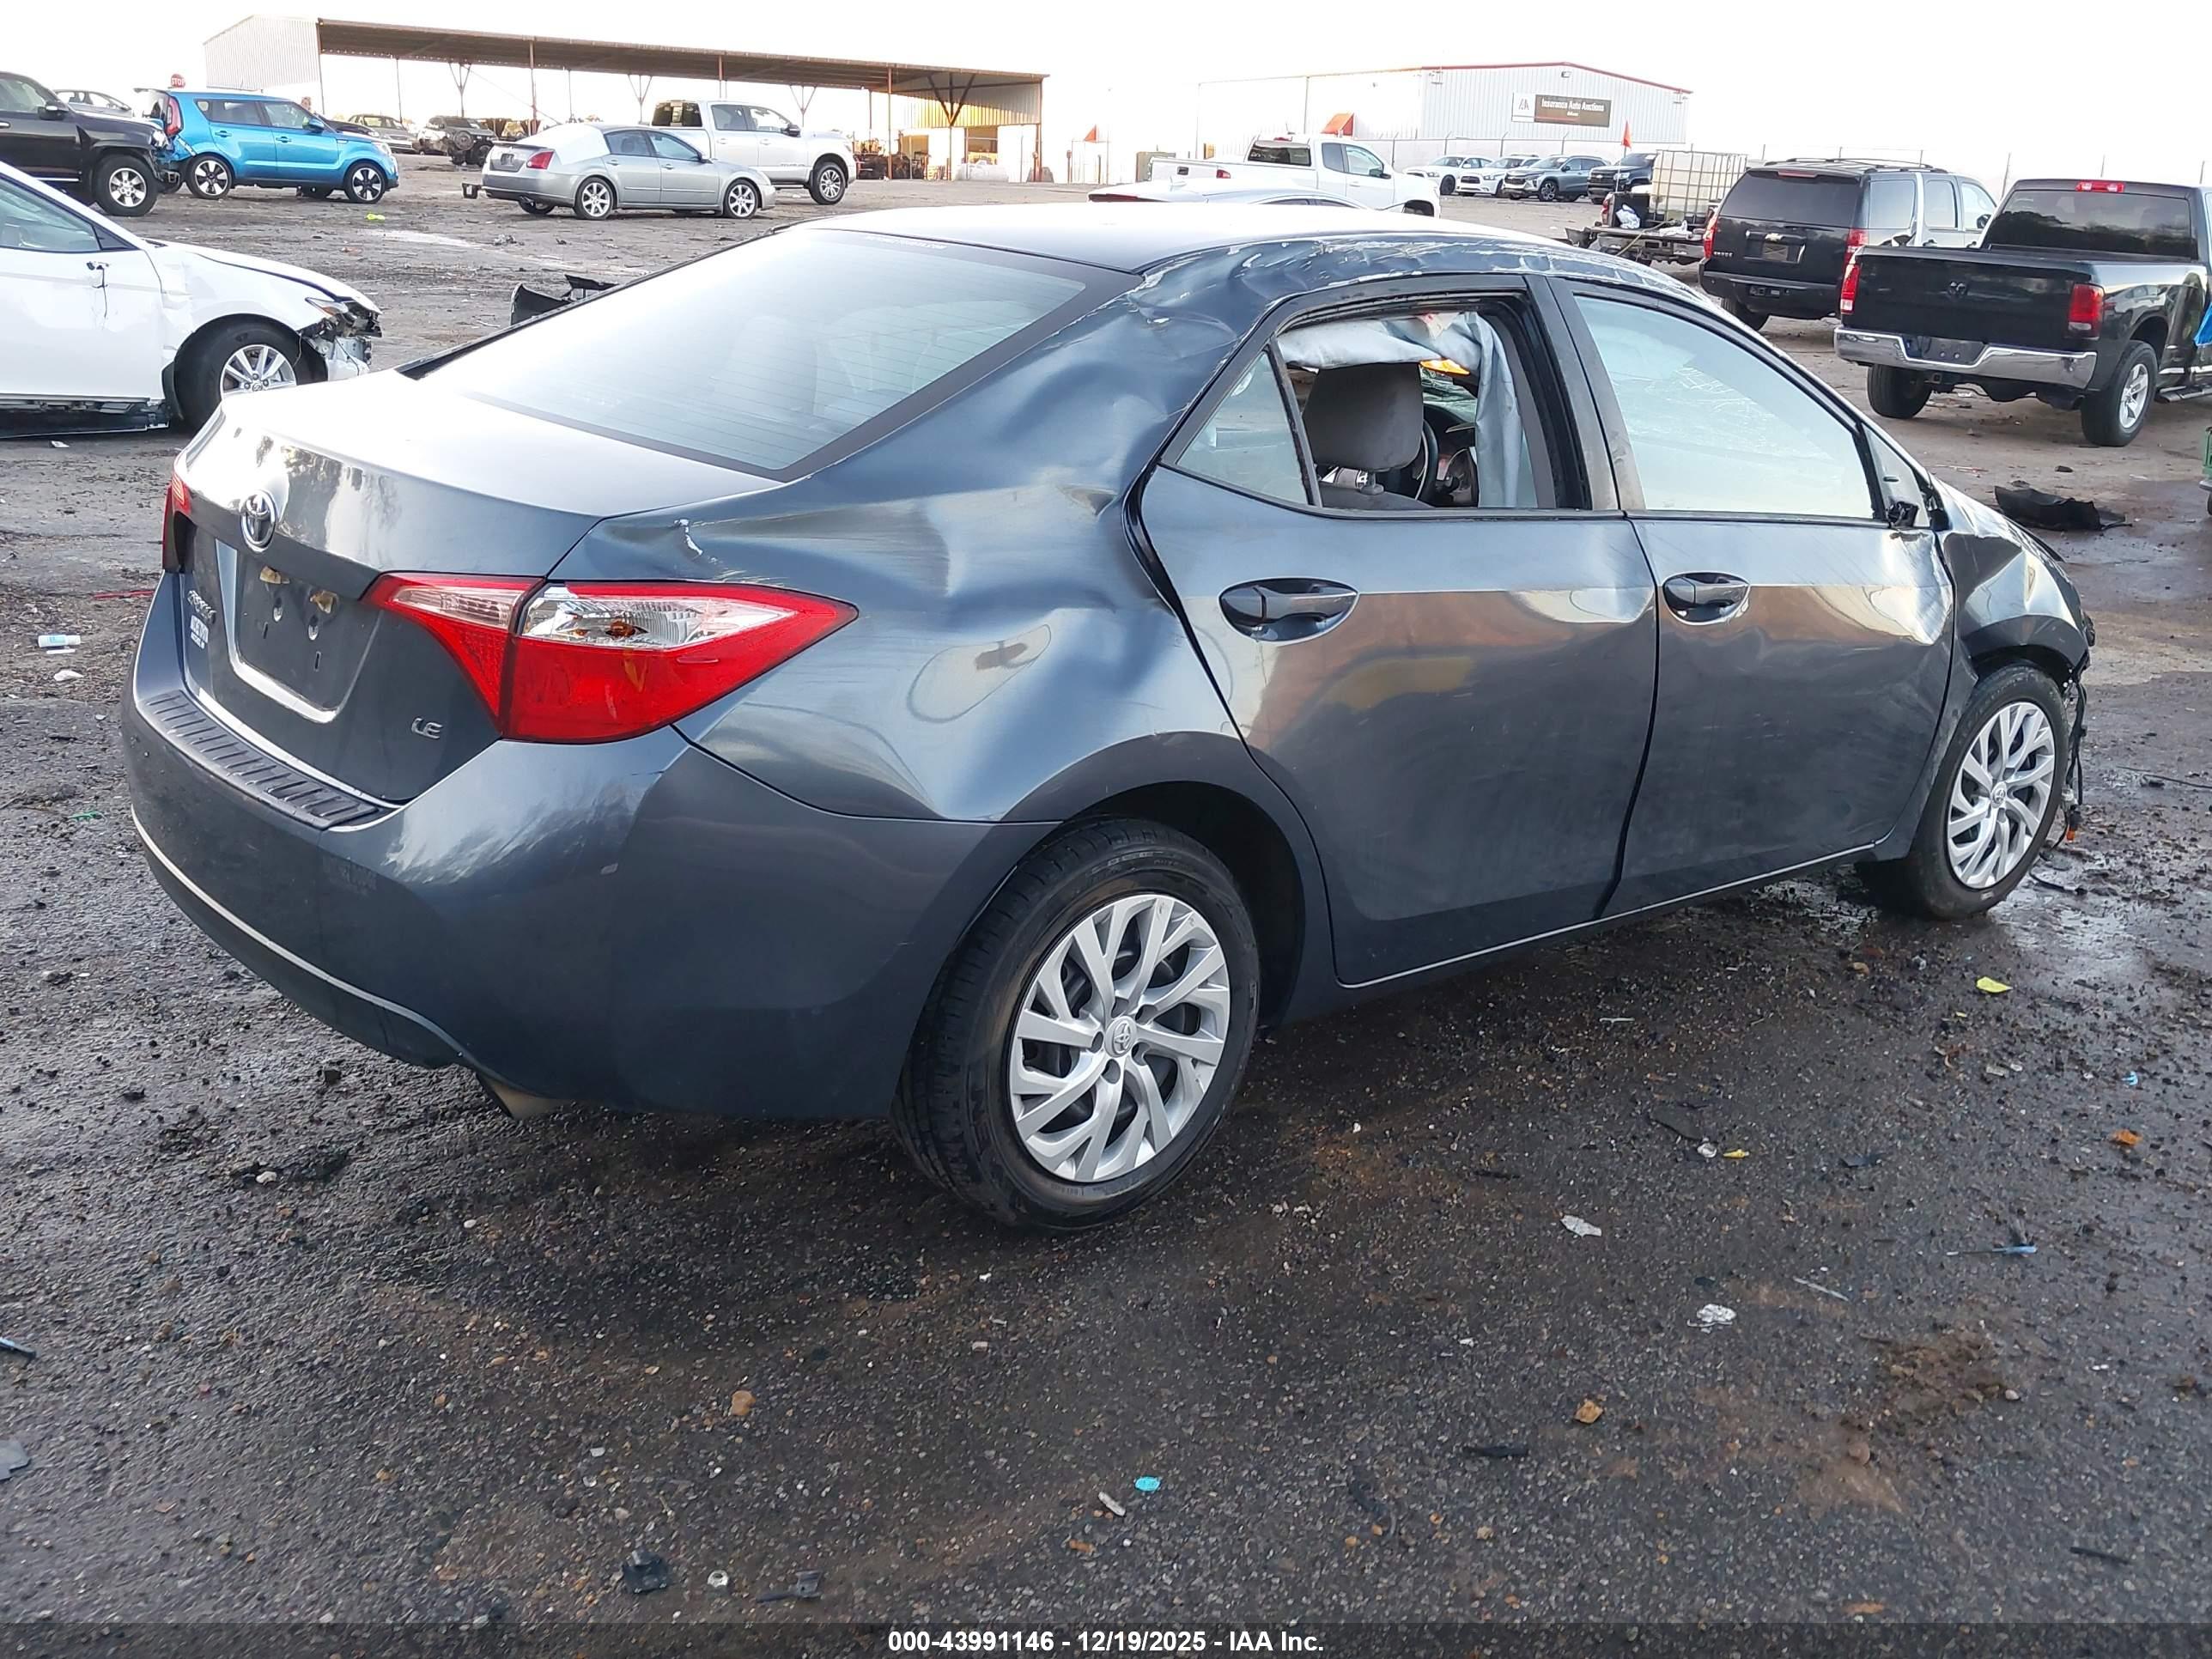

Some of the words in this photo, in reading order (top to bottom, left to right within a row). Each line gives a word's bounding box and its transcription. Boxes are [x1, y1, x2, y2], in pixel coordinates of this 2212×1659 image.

[172, 77, 185, 86] STOP
[1541, 97, 1567, 109] Insurance
[1568, 100, 1581, 110] Auto
[1582, 101, 1605, 112] Auctions
[410, 717, 443, 739] LE
